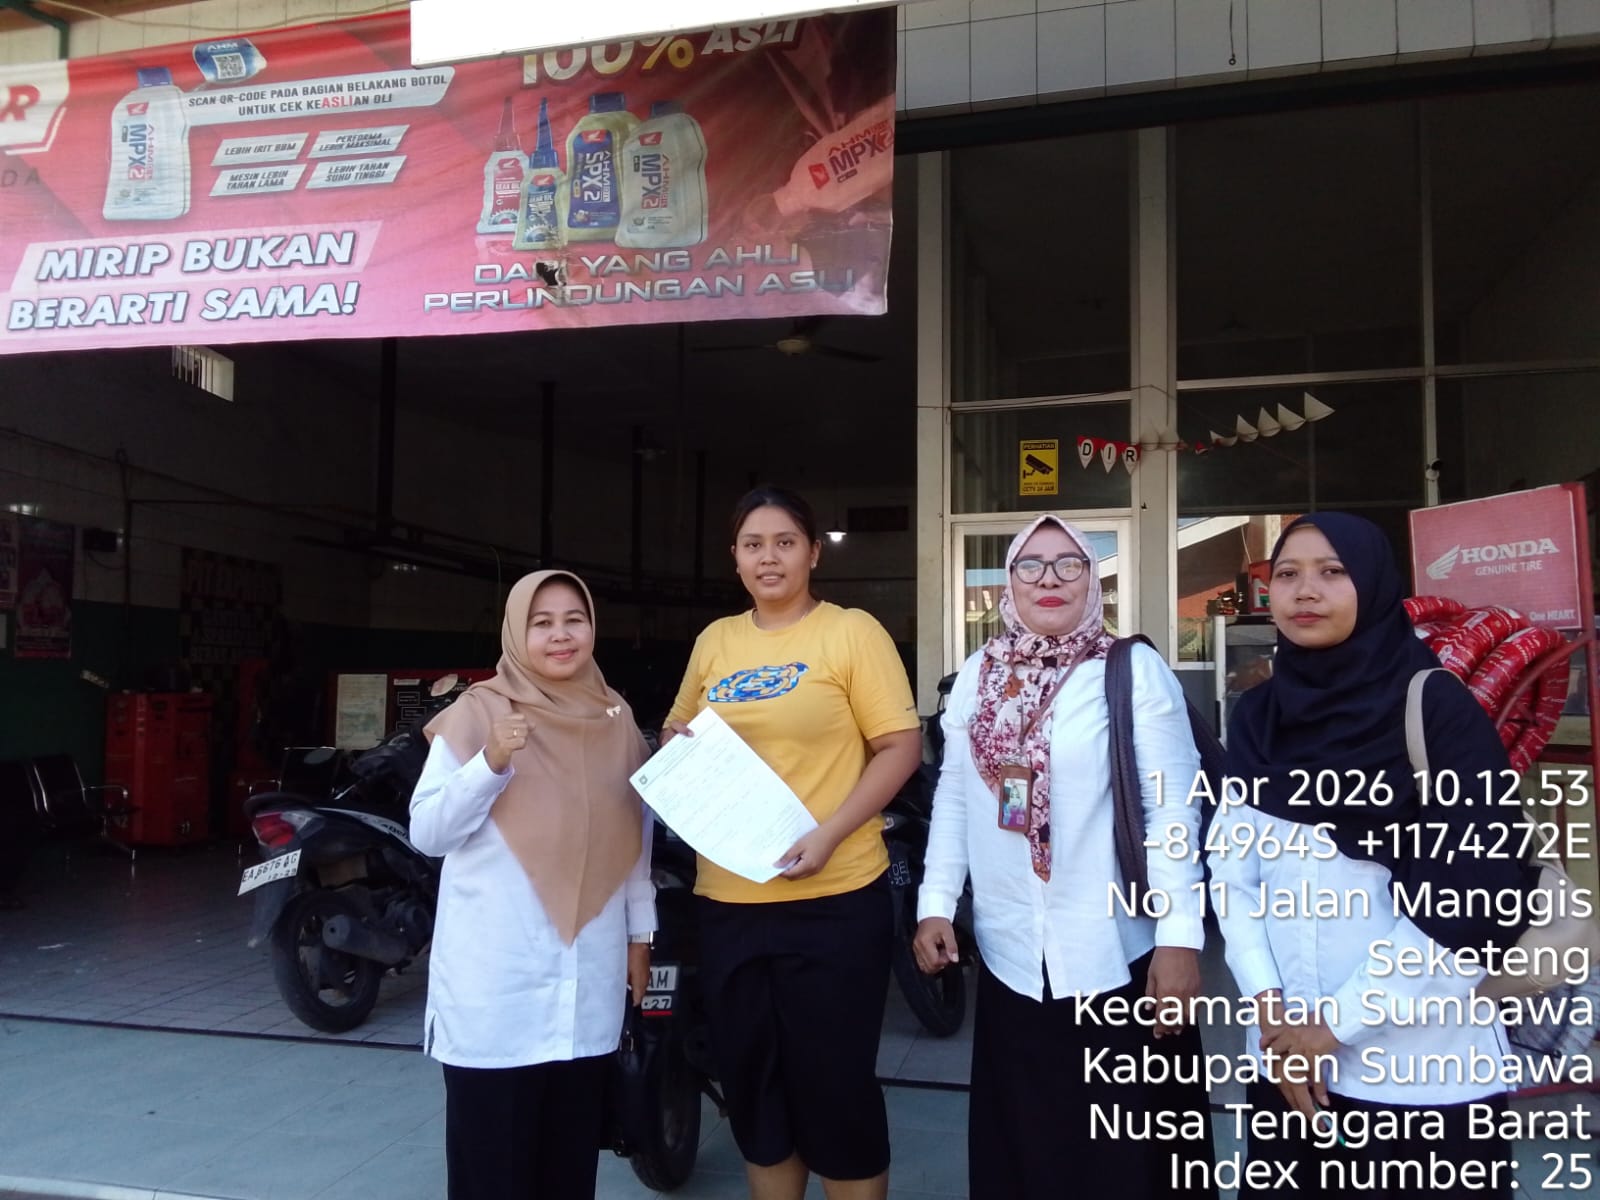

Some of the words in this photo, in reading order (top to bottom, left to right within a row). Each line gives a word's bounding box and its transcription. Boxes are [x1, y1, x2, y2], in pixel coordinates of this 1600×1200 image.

[701, 18, 798, 55] ASLI
[188, 96, 216, 107] SCAN
[219, 91, 267, 105] QR-CODE
[270, 88, 299, 99] PADA
[302, 84, 344, 96] BAGIAN
[346, 79, 407, 92] BELAKANG
[411, 75, 447, 87] BOTOL
[238, 103, 276, 116] UNTUK
[280, 101, 303, 112] CEK
[306, 94, 369, 111] KEASLIAN
[373, 94, 393, 105] OLI
[224, 146, 251, 156] LEBIH
[253, 145, 272, 154] IRIT
[274, 143, 297, 152] BBM
[319, 143, 344, 152] LEBIH
[345, 138, 392, 149] MAKSIMAL
[336, 133, 383, 143] PERFORMA
[128, 124, 147, 181] MPX2
[229, 172, 259, 182] MESIN
[261, 170, 289, 179] LEBIH
[325, 173, 352, 182] SUHU
[353, 170, 386, 180] TINGGI
[328, 165, 356, 174] LEBIH
[358, 162, 390, 171] TAHAN
[582, 152, 604, 201] SPX2
[226, 181, 257, 190] TAHAN
[258, 179, 284, 188] LAMA
[641, 154, 662, 209] MPX2
[36, 243, 172, 282] MIRIP
[182, 231, 356, 273] BUKAN
[581, 250, 691, 277] YANG
[703, 243, 799, 270] AHLI
[424, 274, 743, 313] PERLINDUNGAN
[755, 269, 854, 295] ASLI
[7, 291, 190, 332] BERARTI
[200, 280, 361, 321] SAMA!
[1461, 538, 1560, 564] HONDA
[1475, 563, 1518, 576] GENUINE
[1520, 560, 1543, 571] TIRE
[1530, 611, 1546, 622] One
